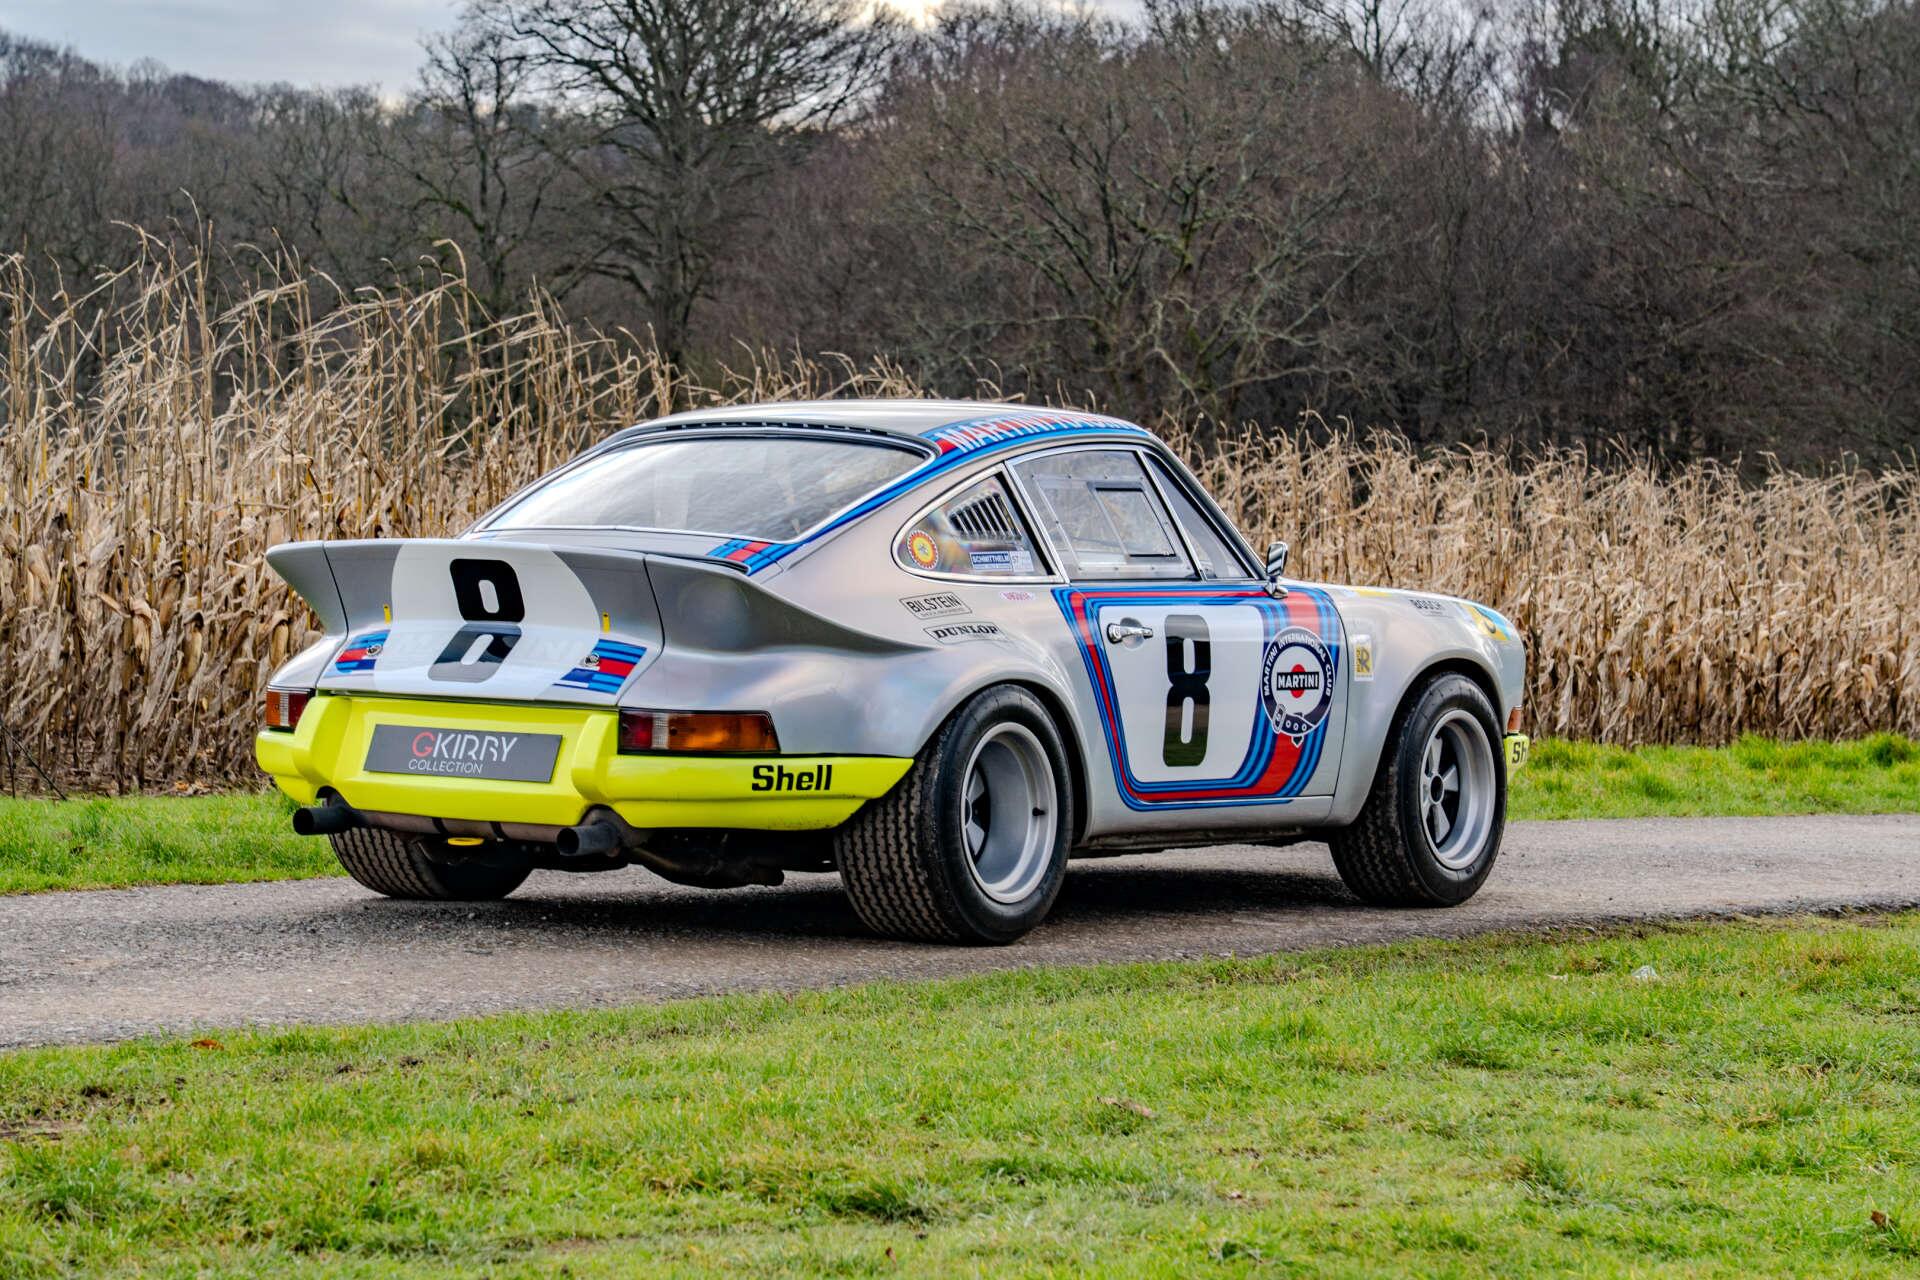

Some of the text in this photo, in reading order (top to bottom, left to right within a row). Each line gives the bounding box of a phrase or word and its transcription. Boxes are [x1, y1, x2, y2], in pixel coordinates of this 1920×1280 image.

[934, 417, 1056, 453] MARTINI
[906, 595, 961, 613] BILSTEIN
[933, 625, 999, 638] DUNLOP
[1263, 646, 1278, 696] MARTINI
[1278, 632, 1327, 662] INTERNATIONAL
[1163, 615, 1211, 767] 8
[1277, 674, 1318, 689] MARTINI
[408, 758, 483, 774] COLLECTION
[752, 765, 832, 791] Shell
